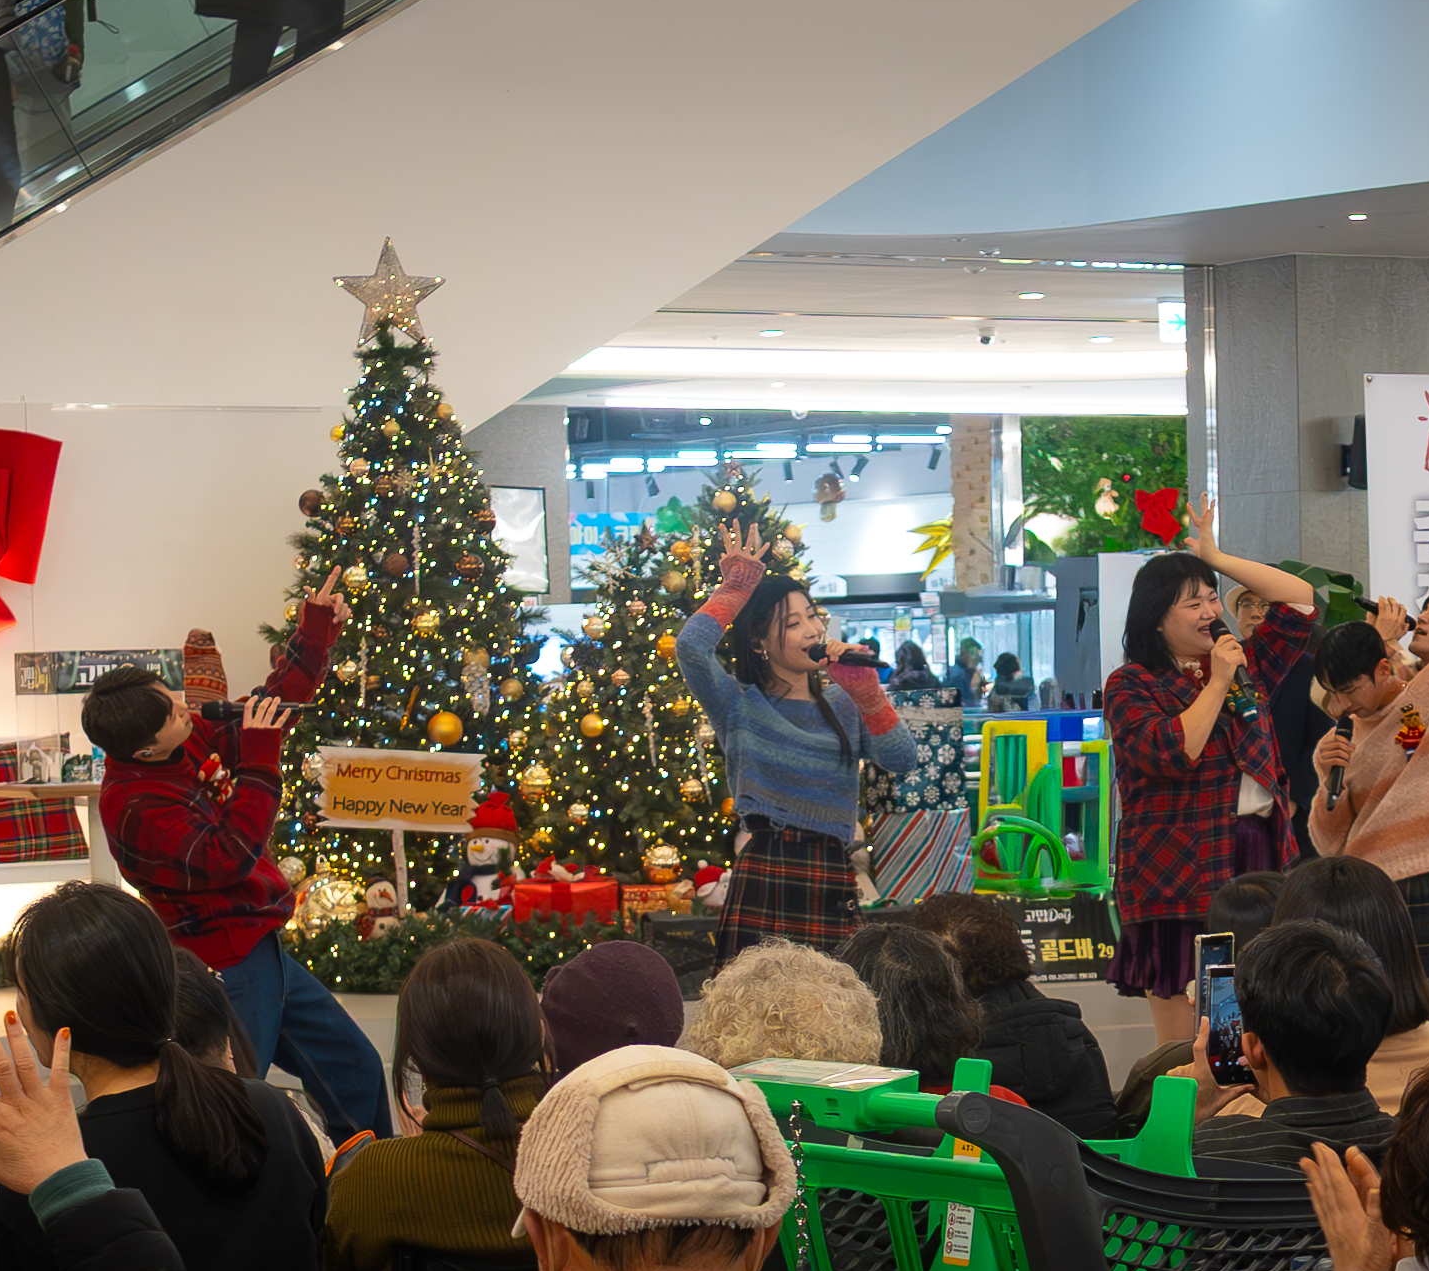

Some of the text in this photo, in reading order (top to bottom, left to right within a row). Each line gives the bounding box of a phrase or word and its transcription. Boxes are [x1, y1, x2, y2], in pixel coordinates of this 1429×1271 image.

[335, 763, 462, 784] Merry Christmas
[332, 796, 467, 817] Happy New Year
[1040, 938, 1094, 962] 골드바
[1097, 943, 1115, 959] 2g
